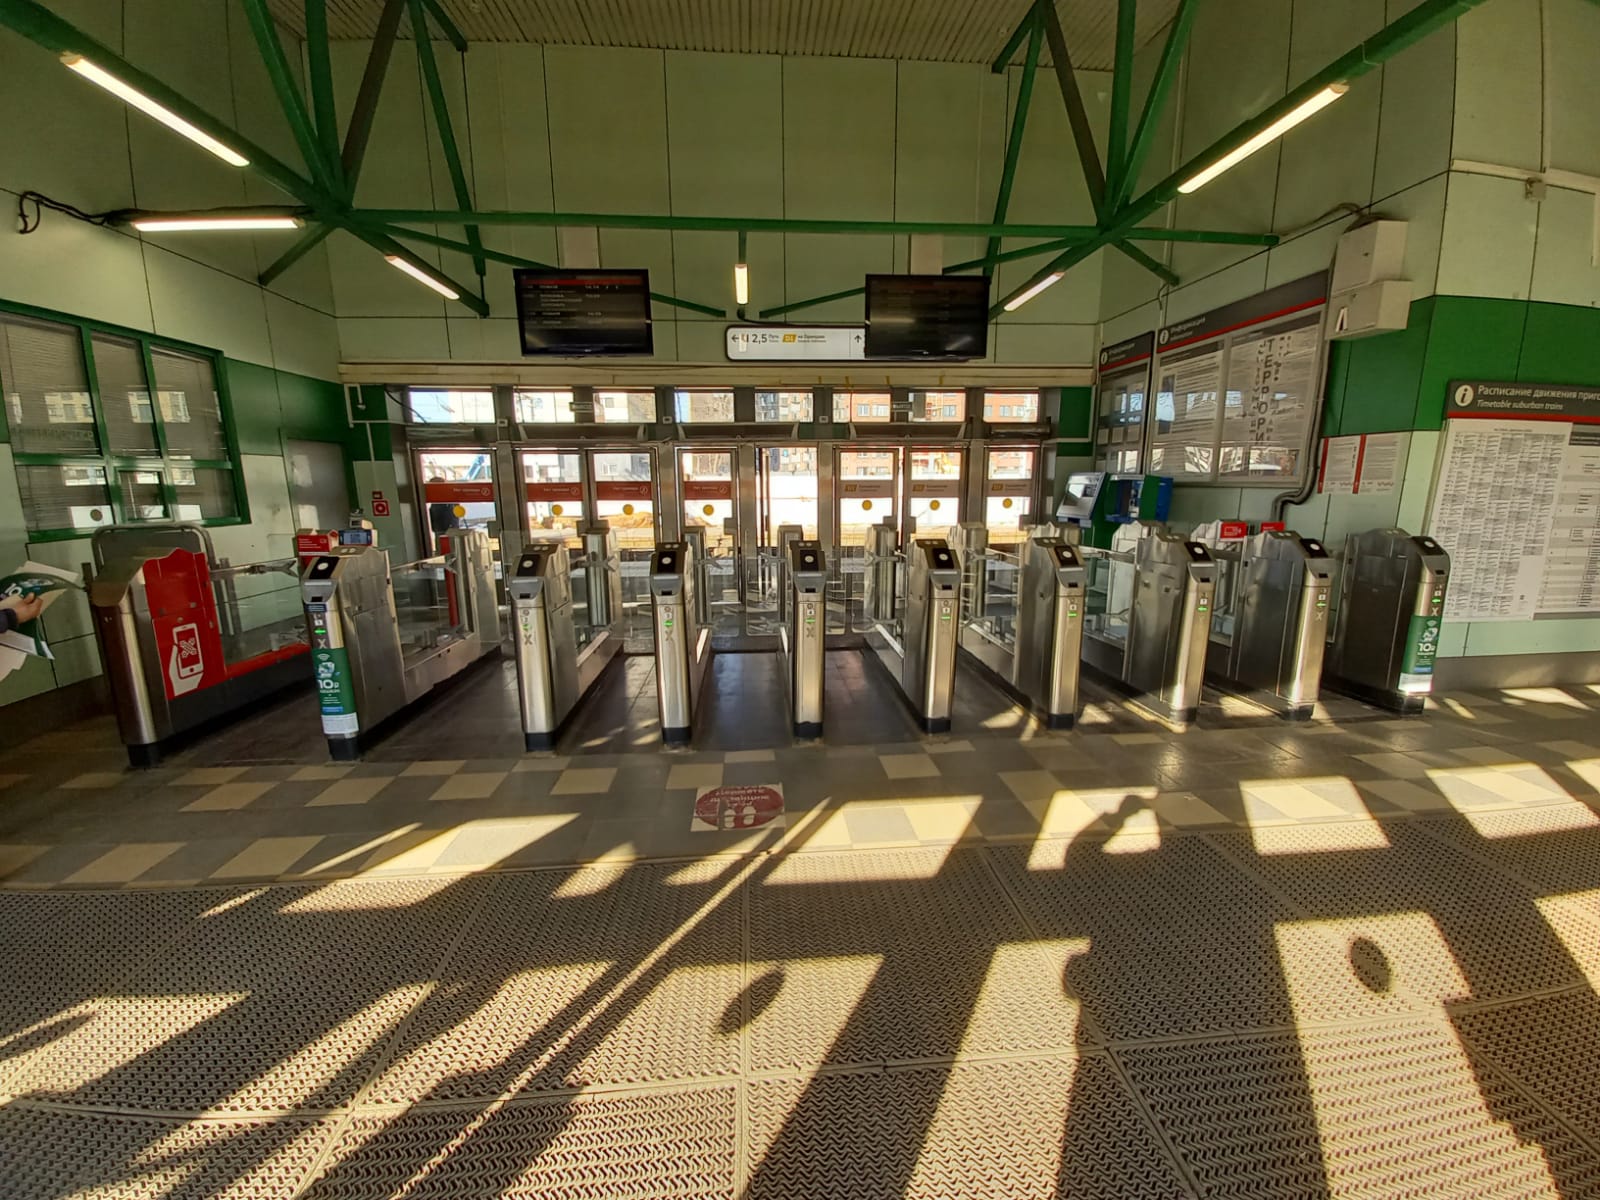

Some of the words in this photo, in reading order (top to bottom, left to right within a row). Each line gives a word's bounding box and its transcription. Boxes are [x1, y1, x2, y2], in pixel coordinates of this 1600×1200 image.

[752, 333, 767, 344] 2,5
[1478, 385, 1531, 397] Расписание
[1533, 388, 1577, 399] движения
[1477, 399, 1512, 409] Timetable
[1512, 400, 1545, 410] suburban
[1545, 402, 1564, 411] trains
